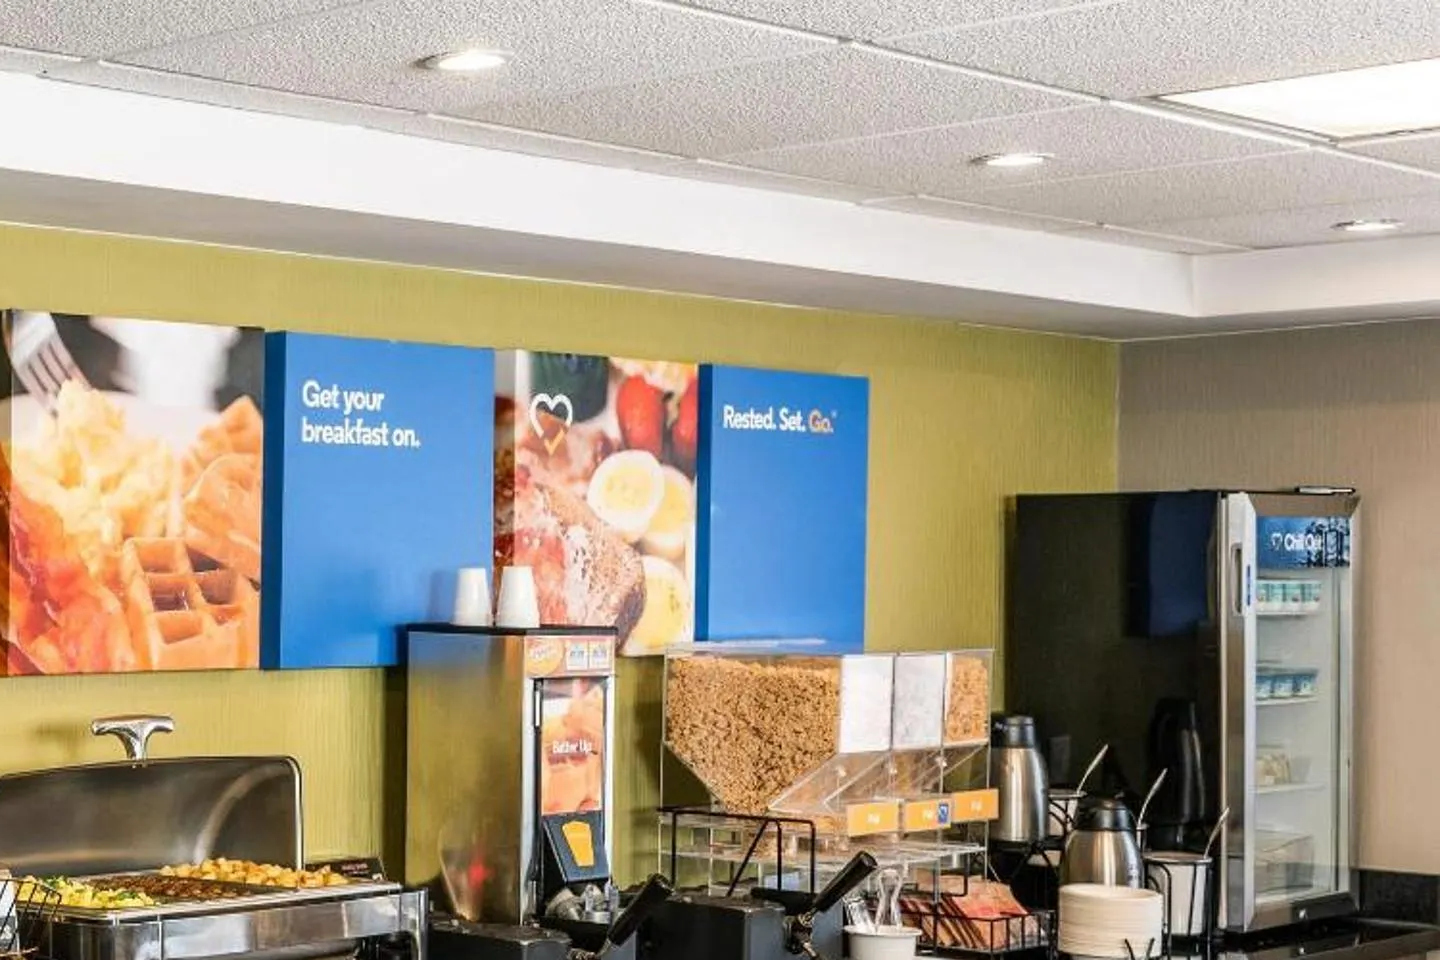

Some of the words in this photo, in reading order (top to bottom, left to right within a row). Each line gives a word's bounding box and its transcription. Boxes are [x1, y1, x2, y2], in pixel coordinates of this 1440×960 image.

[302, 379, 339, 408] Get
[343, 390, 385, 415] your
[301, 416, 389, 446] breakfast
[392, 428, 421, 449] on.
[722, 404, 777, 430] Rested.
[779, 407, 806, 432] Set.
